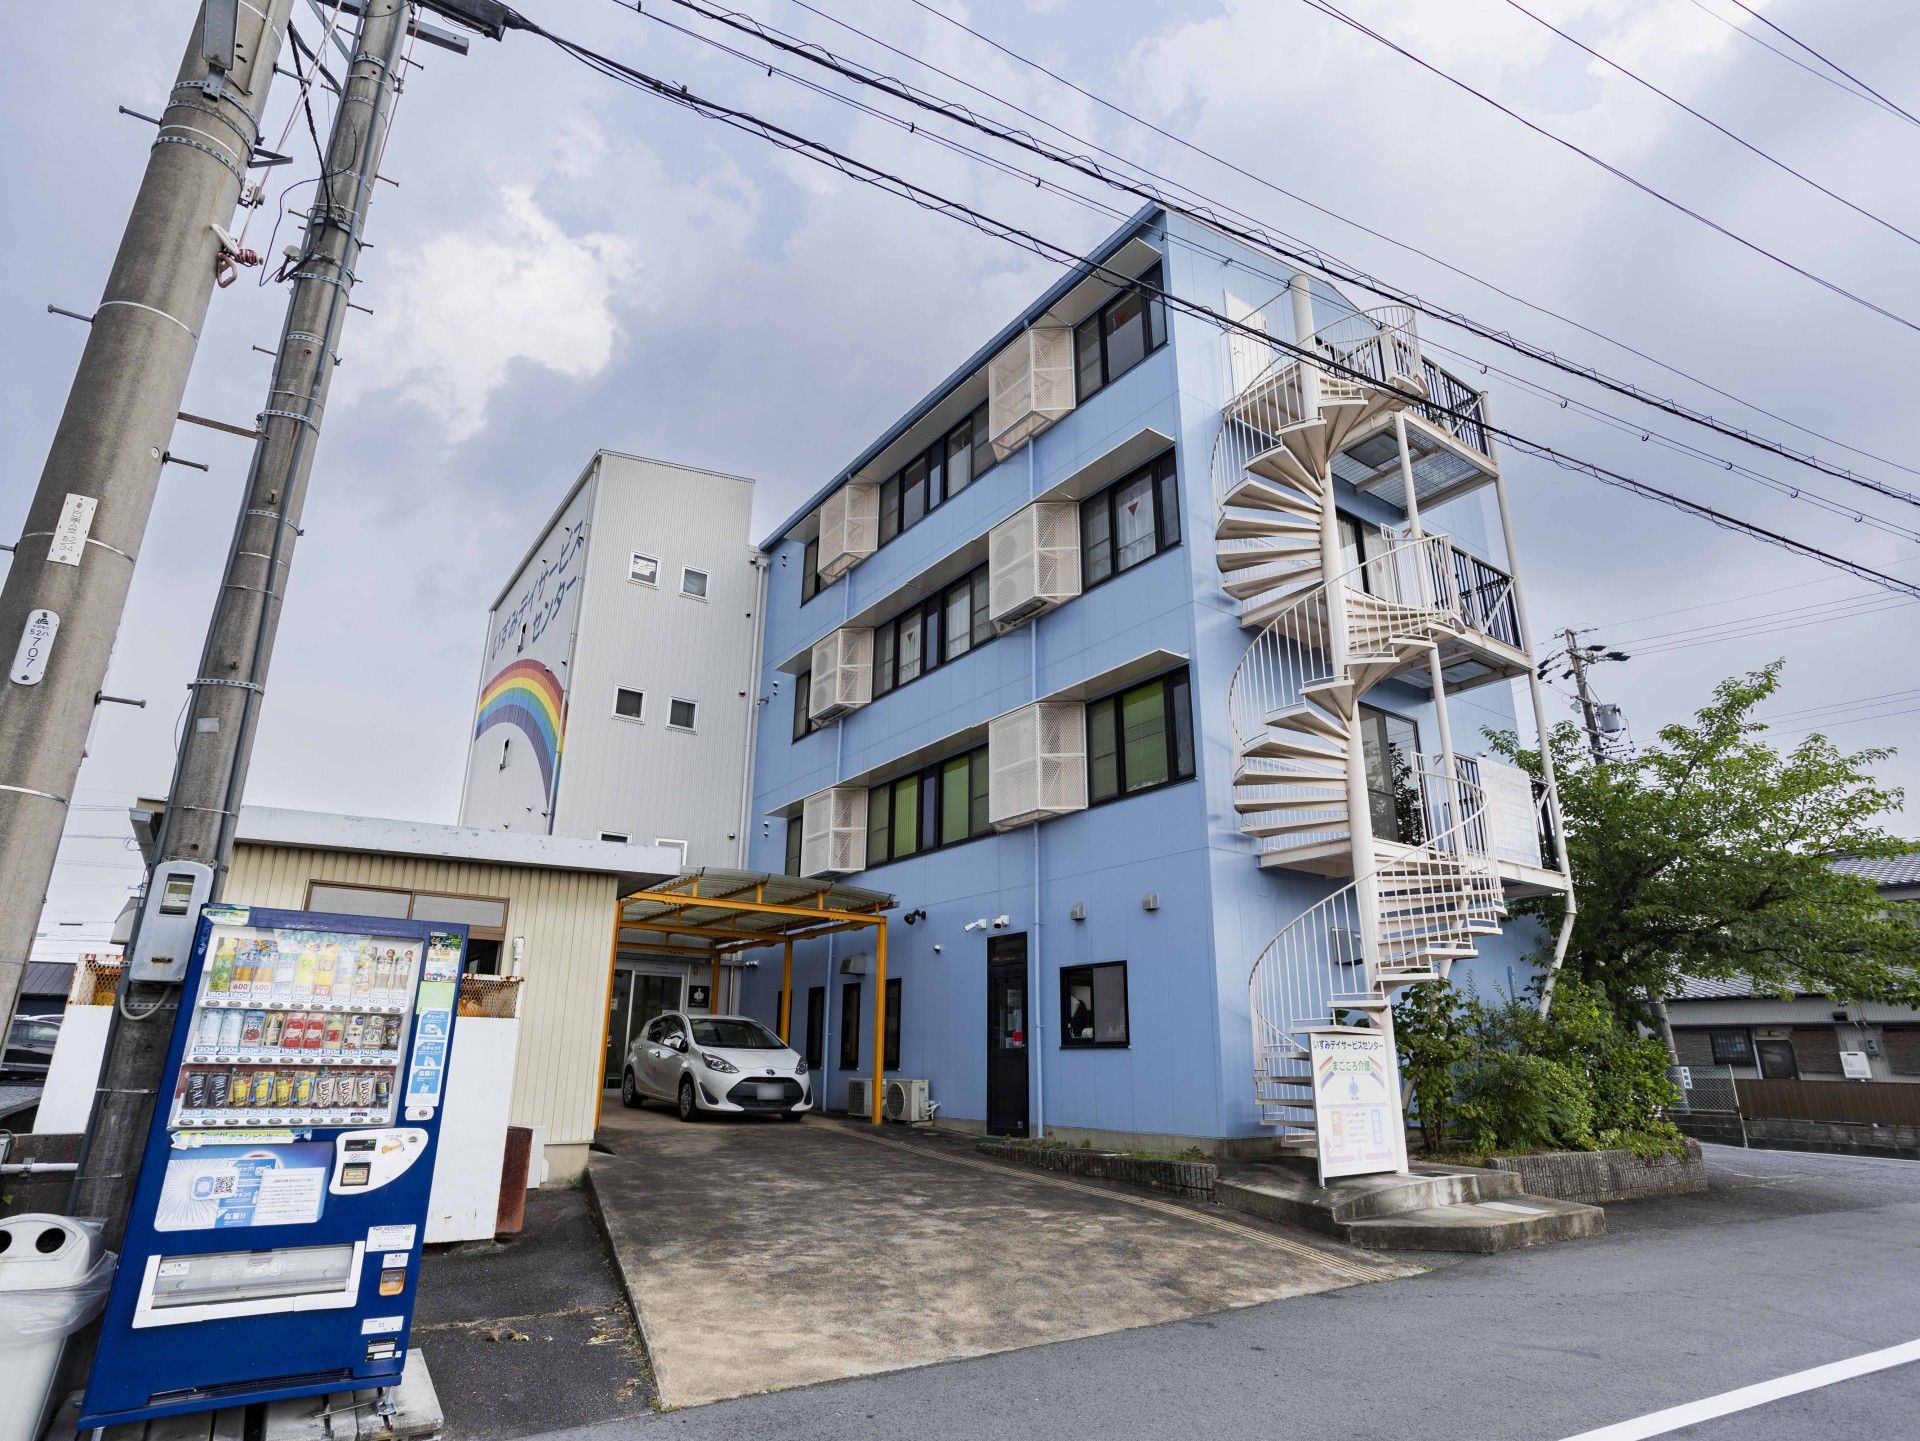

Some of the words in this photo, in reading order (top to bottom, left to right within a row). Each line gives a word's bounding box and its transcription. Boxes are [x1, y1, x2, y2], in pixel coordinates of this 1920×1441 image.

[532, 576, 577, 643] センター
[26, 636, 42, 668] 707
[1313, 1038, 1384, 1050] いずみデイサービスセンター
[1331, 1060, 1372, 1072] まごころ介護
[320, 1082, 330, 1106] BOSS
[341, 1082, 350, 1105] BOSS
[361, 1082, 370, 1105] BOSS
